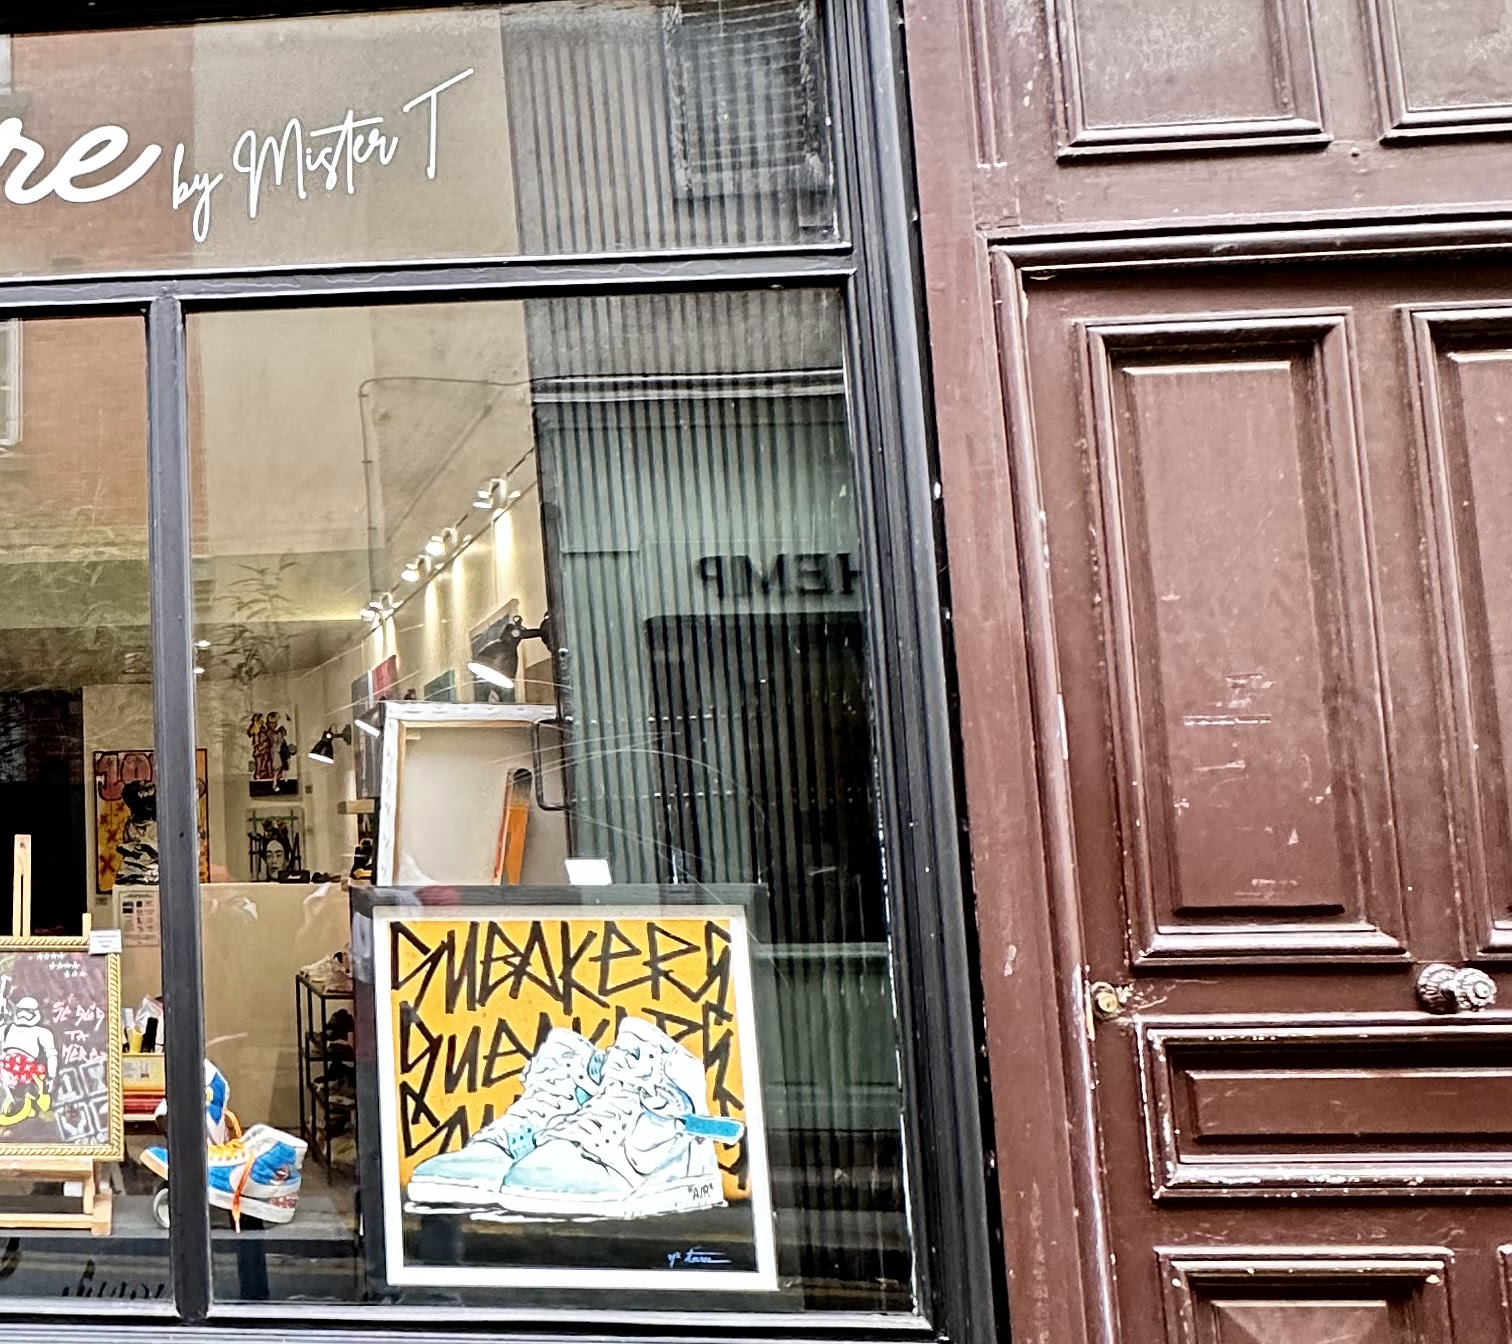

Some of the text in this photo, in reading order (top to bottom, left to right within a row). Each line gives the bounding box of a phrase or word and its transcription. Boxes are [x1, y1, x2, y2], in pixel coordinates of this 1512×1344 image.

[172, 143, 223, 243] by
[232, 110, 398, 218] Mister
[402, 68, 474, 179] T
